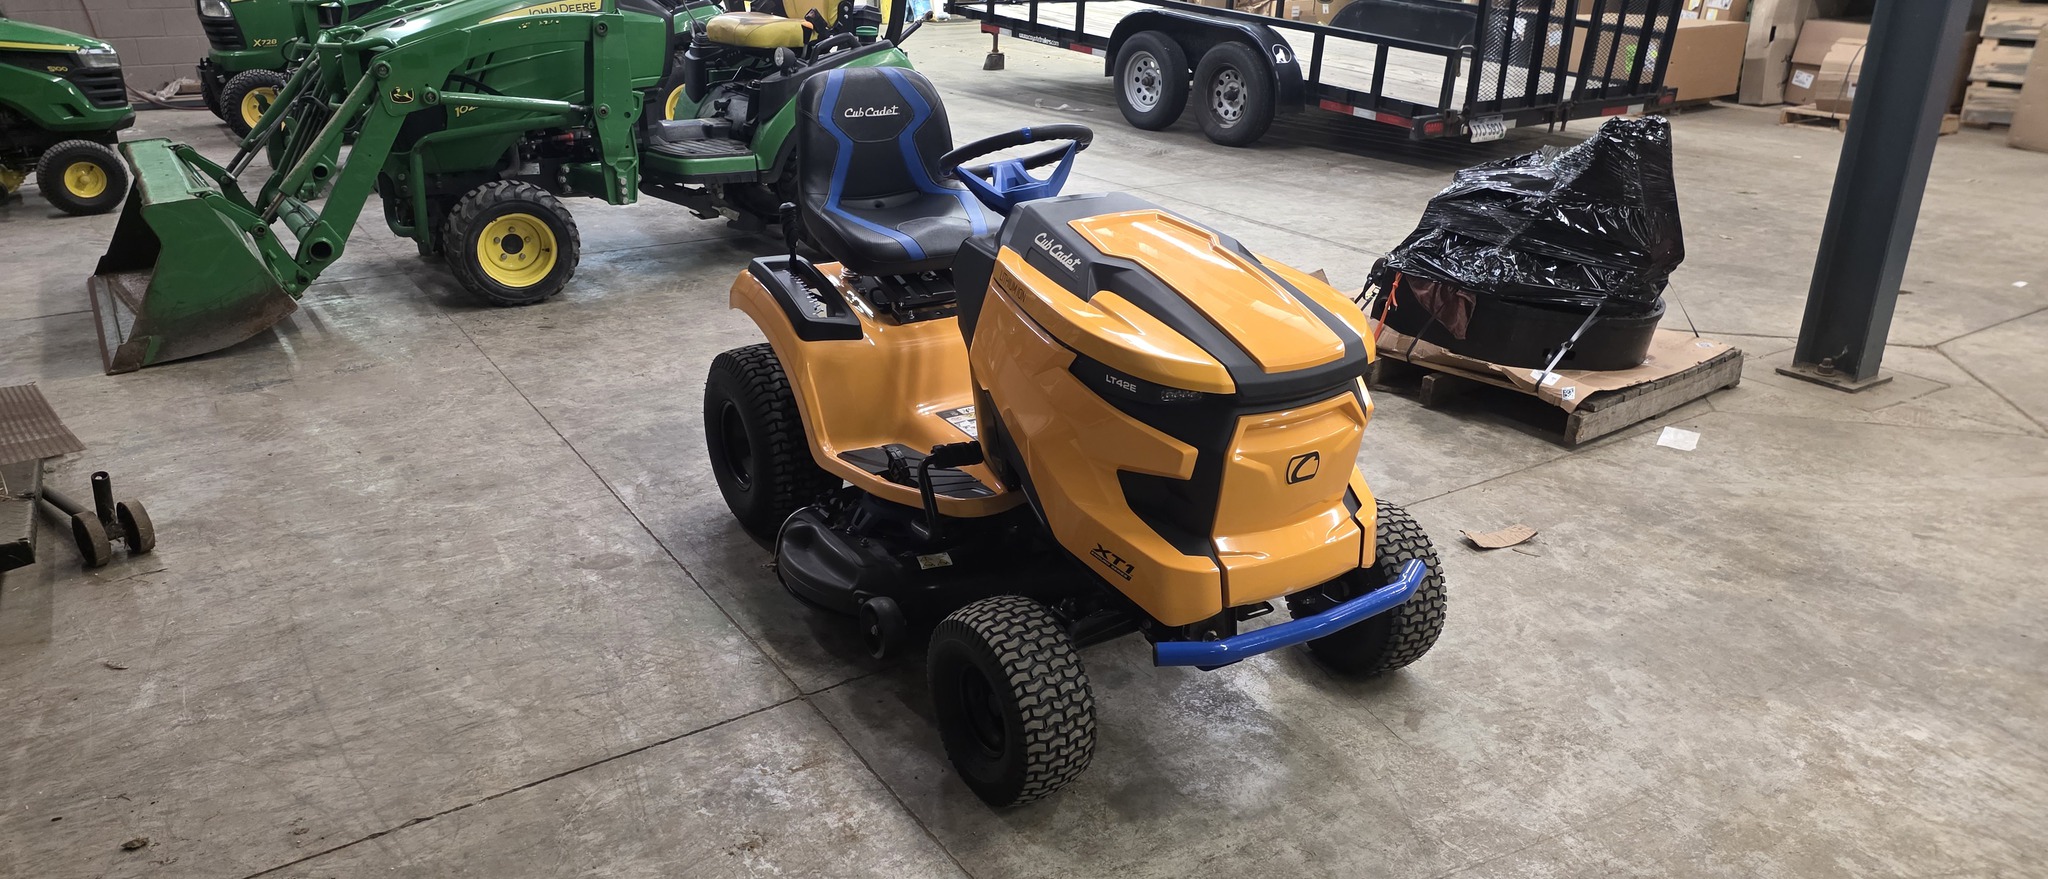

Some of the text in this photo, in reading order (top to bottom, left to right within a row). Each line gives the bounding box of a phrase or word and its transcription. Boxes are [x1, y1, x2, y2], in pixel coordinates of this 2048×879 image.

[559, 2, 597, 13] DEERE
[844, 105, 899, 118] Cub Cadet
[1034, 232, 1081, 272] Cub Cadet
[1105, 374, 1137, 393] LT42E
[1093, 542, 1135, 574] XT1
